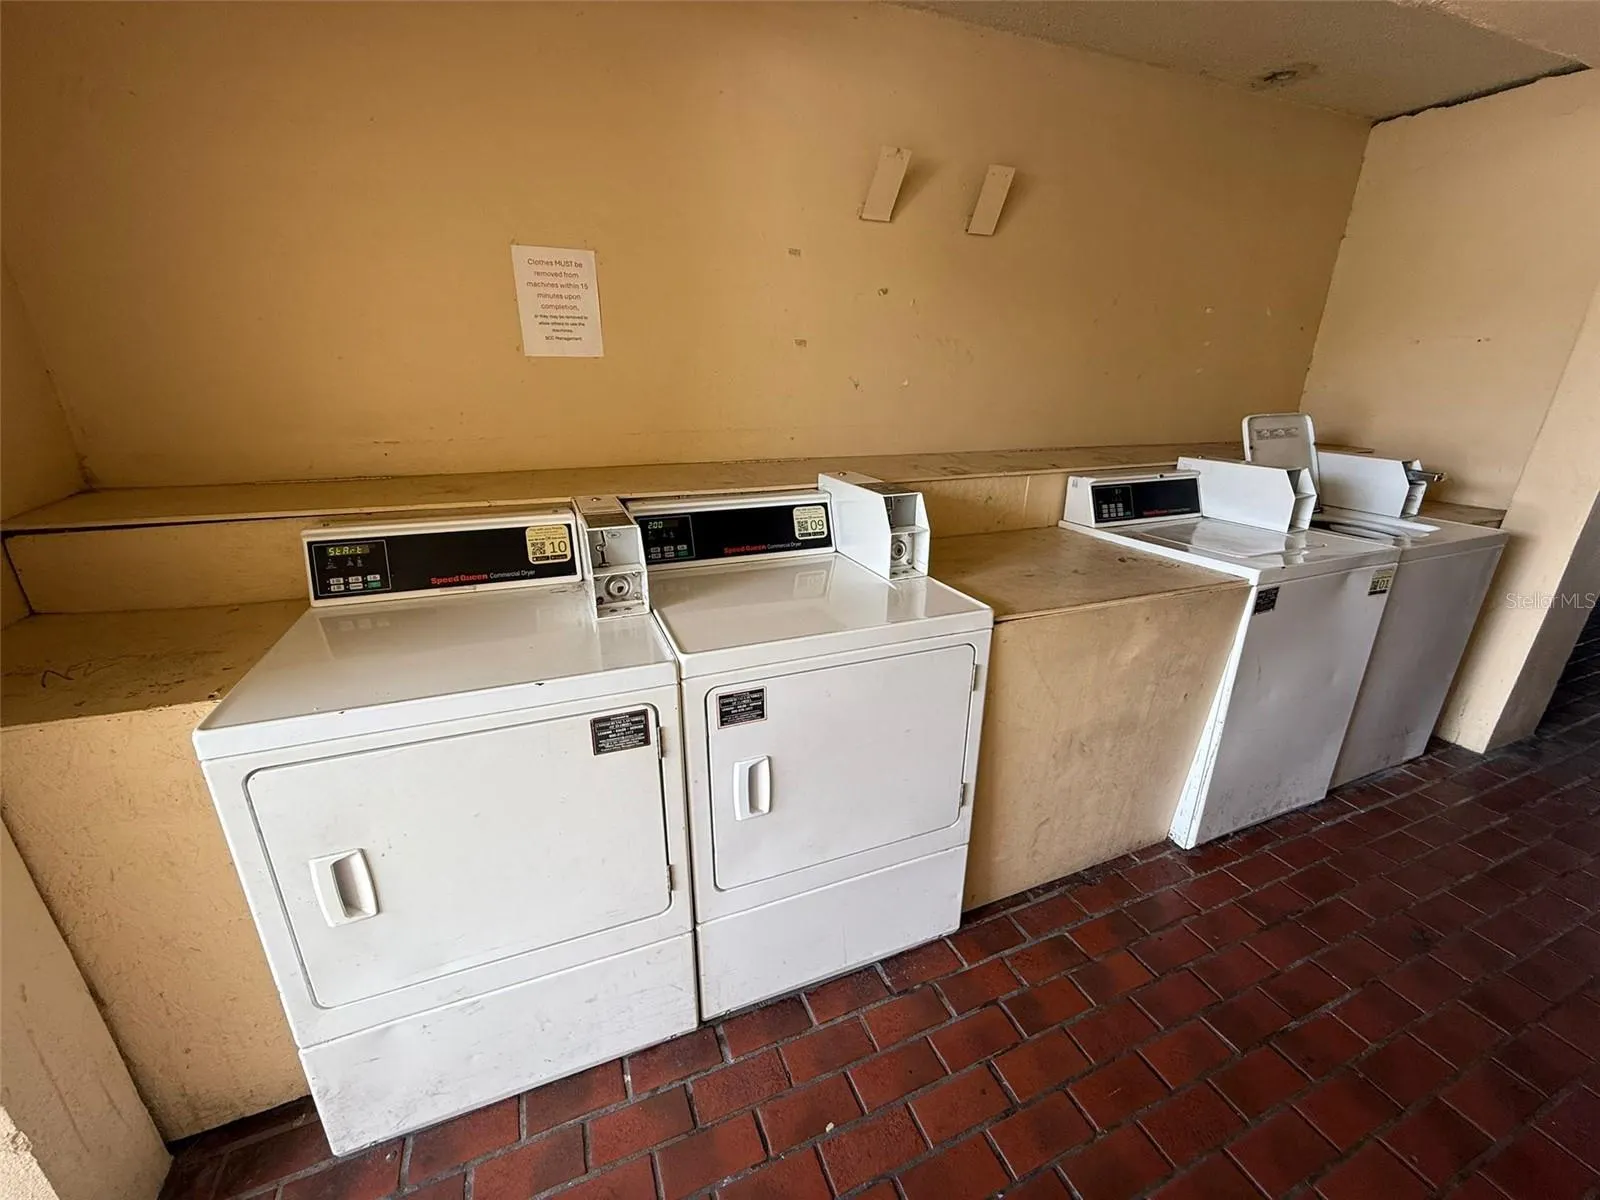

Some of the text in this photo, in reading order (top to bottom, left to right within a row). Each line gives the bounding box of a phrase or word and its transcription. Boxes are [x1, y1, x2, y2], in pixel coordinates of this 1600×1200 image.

[527, 258, 554, 266] Clothes
[555, 259, 573, 267] MUST
[810, 519, 825, 531] 09
[549, 540, 567, 554] 10
[430, 569, 536, 585] Speed Queen Commercial Dryer
[1378, 579, 1391, 590] 01
